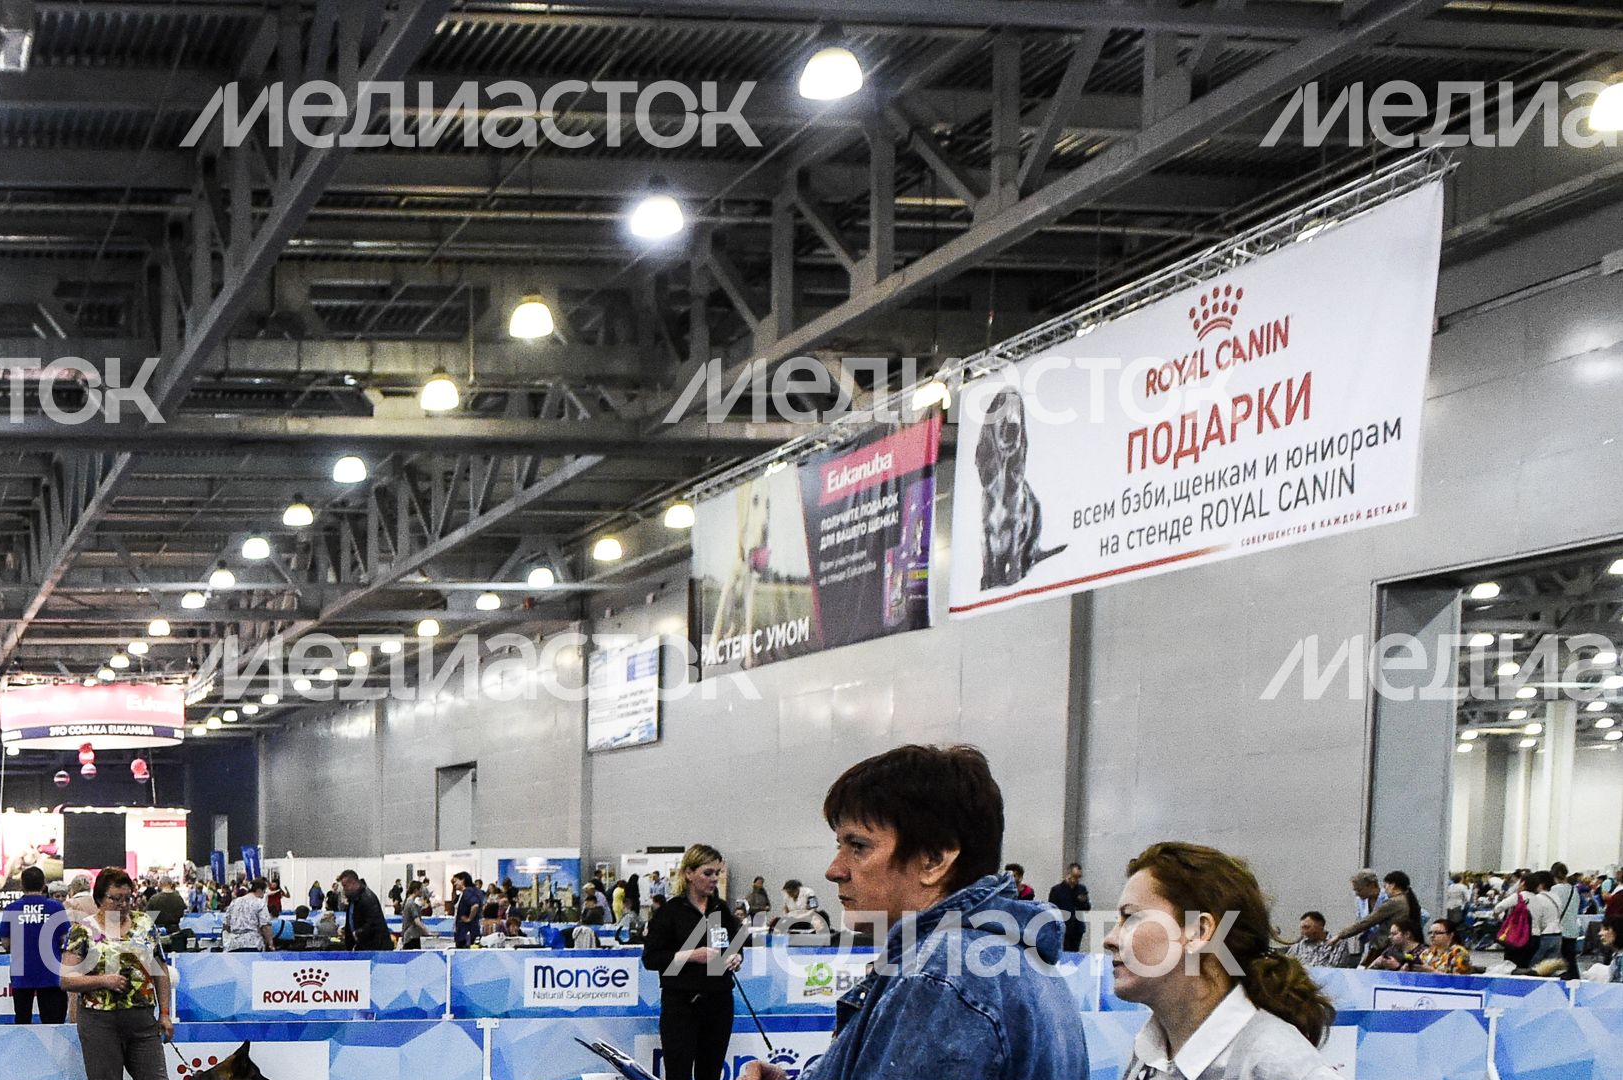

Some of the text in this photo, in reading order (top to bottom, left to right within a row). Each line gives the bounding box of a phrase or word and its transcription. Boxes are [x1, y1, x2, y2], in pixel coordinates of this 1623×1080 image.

[1146, 315, 1290, 398] ROYAL CANIN
[1127, 371, 1312, 474] ПОДАРКИ
[827, 451, 893, 493] Eukanuba
[1073, 499, 1115, 530] всем
[1265, 453, 1278, 476] и
[1286, 417, 1402, 470] юниорам
[1099, 462, 1356, 557] на стенде ROYAL CANIN
[753, 633, 763, 656] С
[766, 616, 811, 651] УМОМ
[18, 914, 50, 924] STAFF
[23, 904, 44, 914] RKF
[263, 989, 359, 1003] ROYAL CANIN
[533, 991, 563, 1000] Natural
